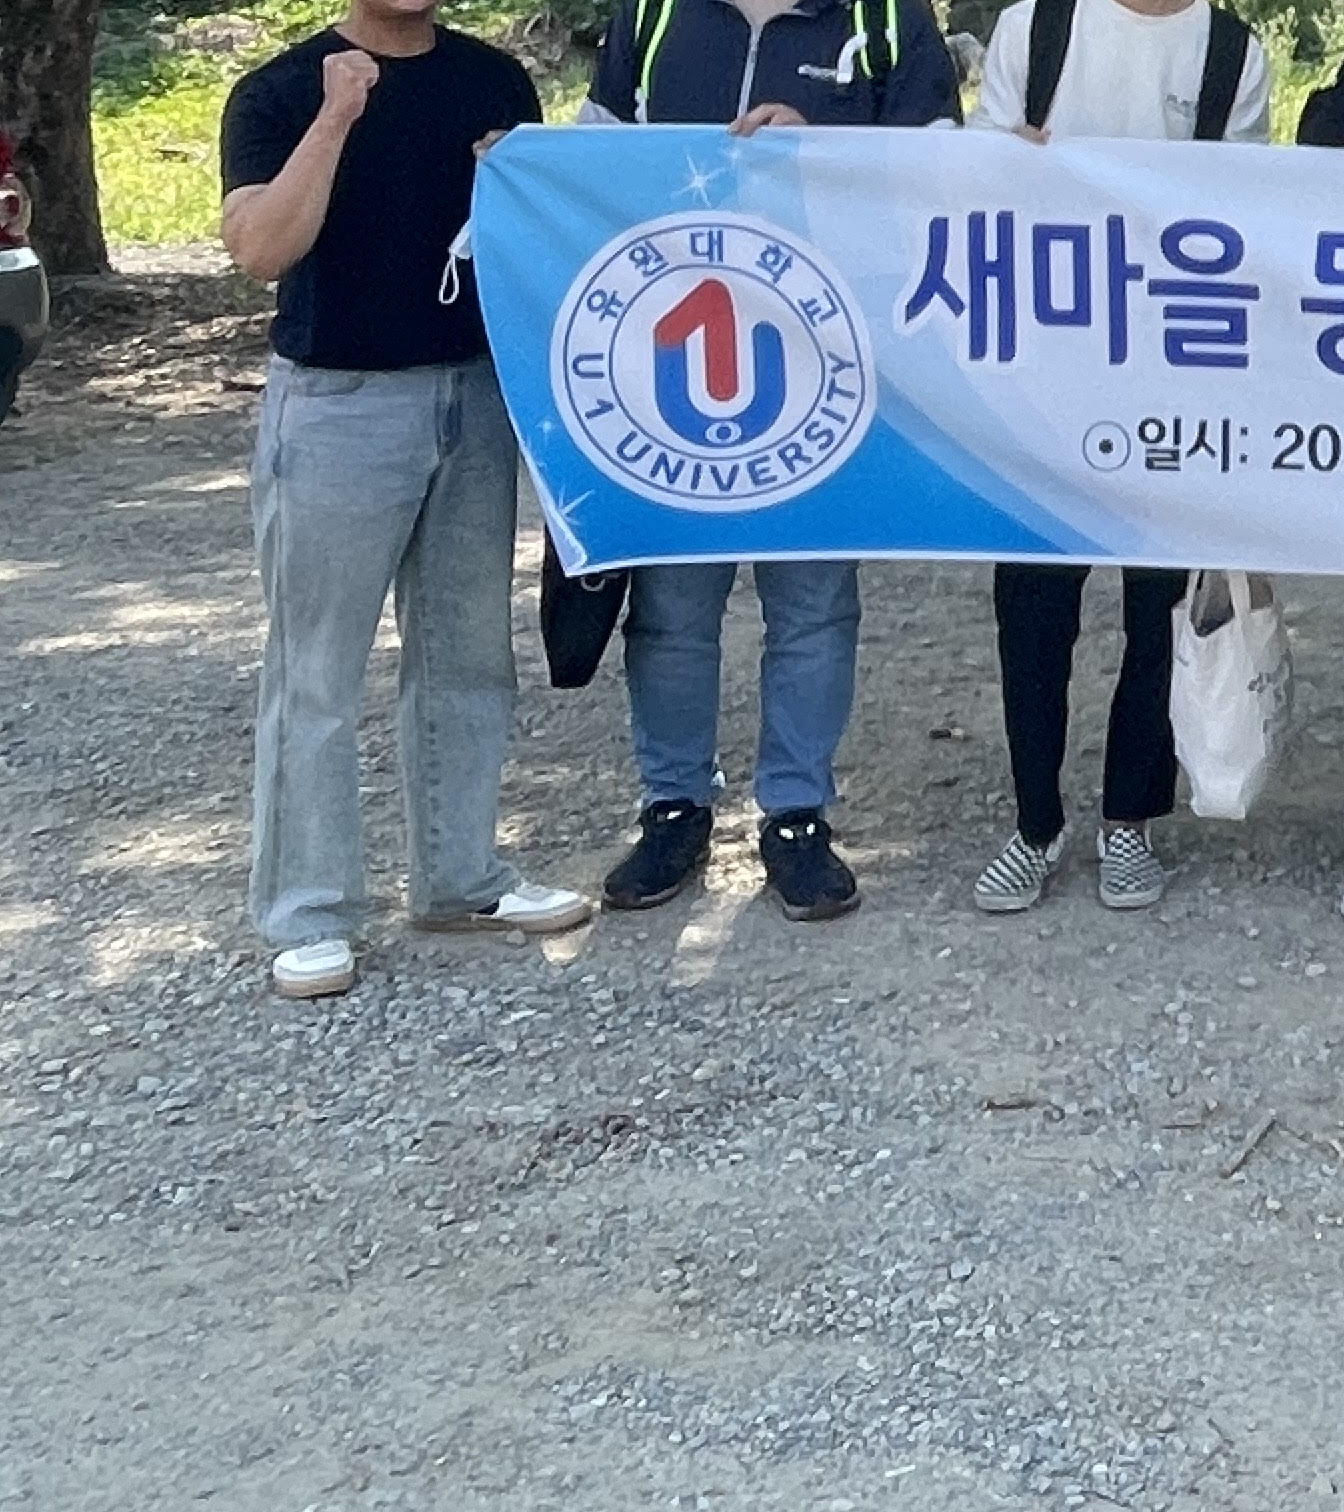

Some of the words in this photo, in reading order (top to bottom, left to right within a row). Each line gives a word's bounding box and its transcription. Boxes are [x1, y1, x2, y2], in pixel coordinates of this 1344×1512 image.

[586, 229, 839, 328] 유원대학교
[906, 210, 1261, 368] 새마을
[616, 350, 857, 492] UNIVERSITY
[1138, 415, 1249, 473] 일시:
